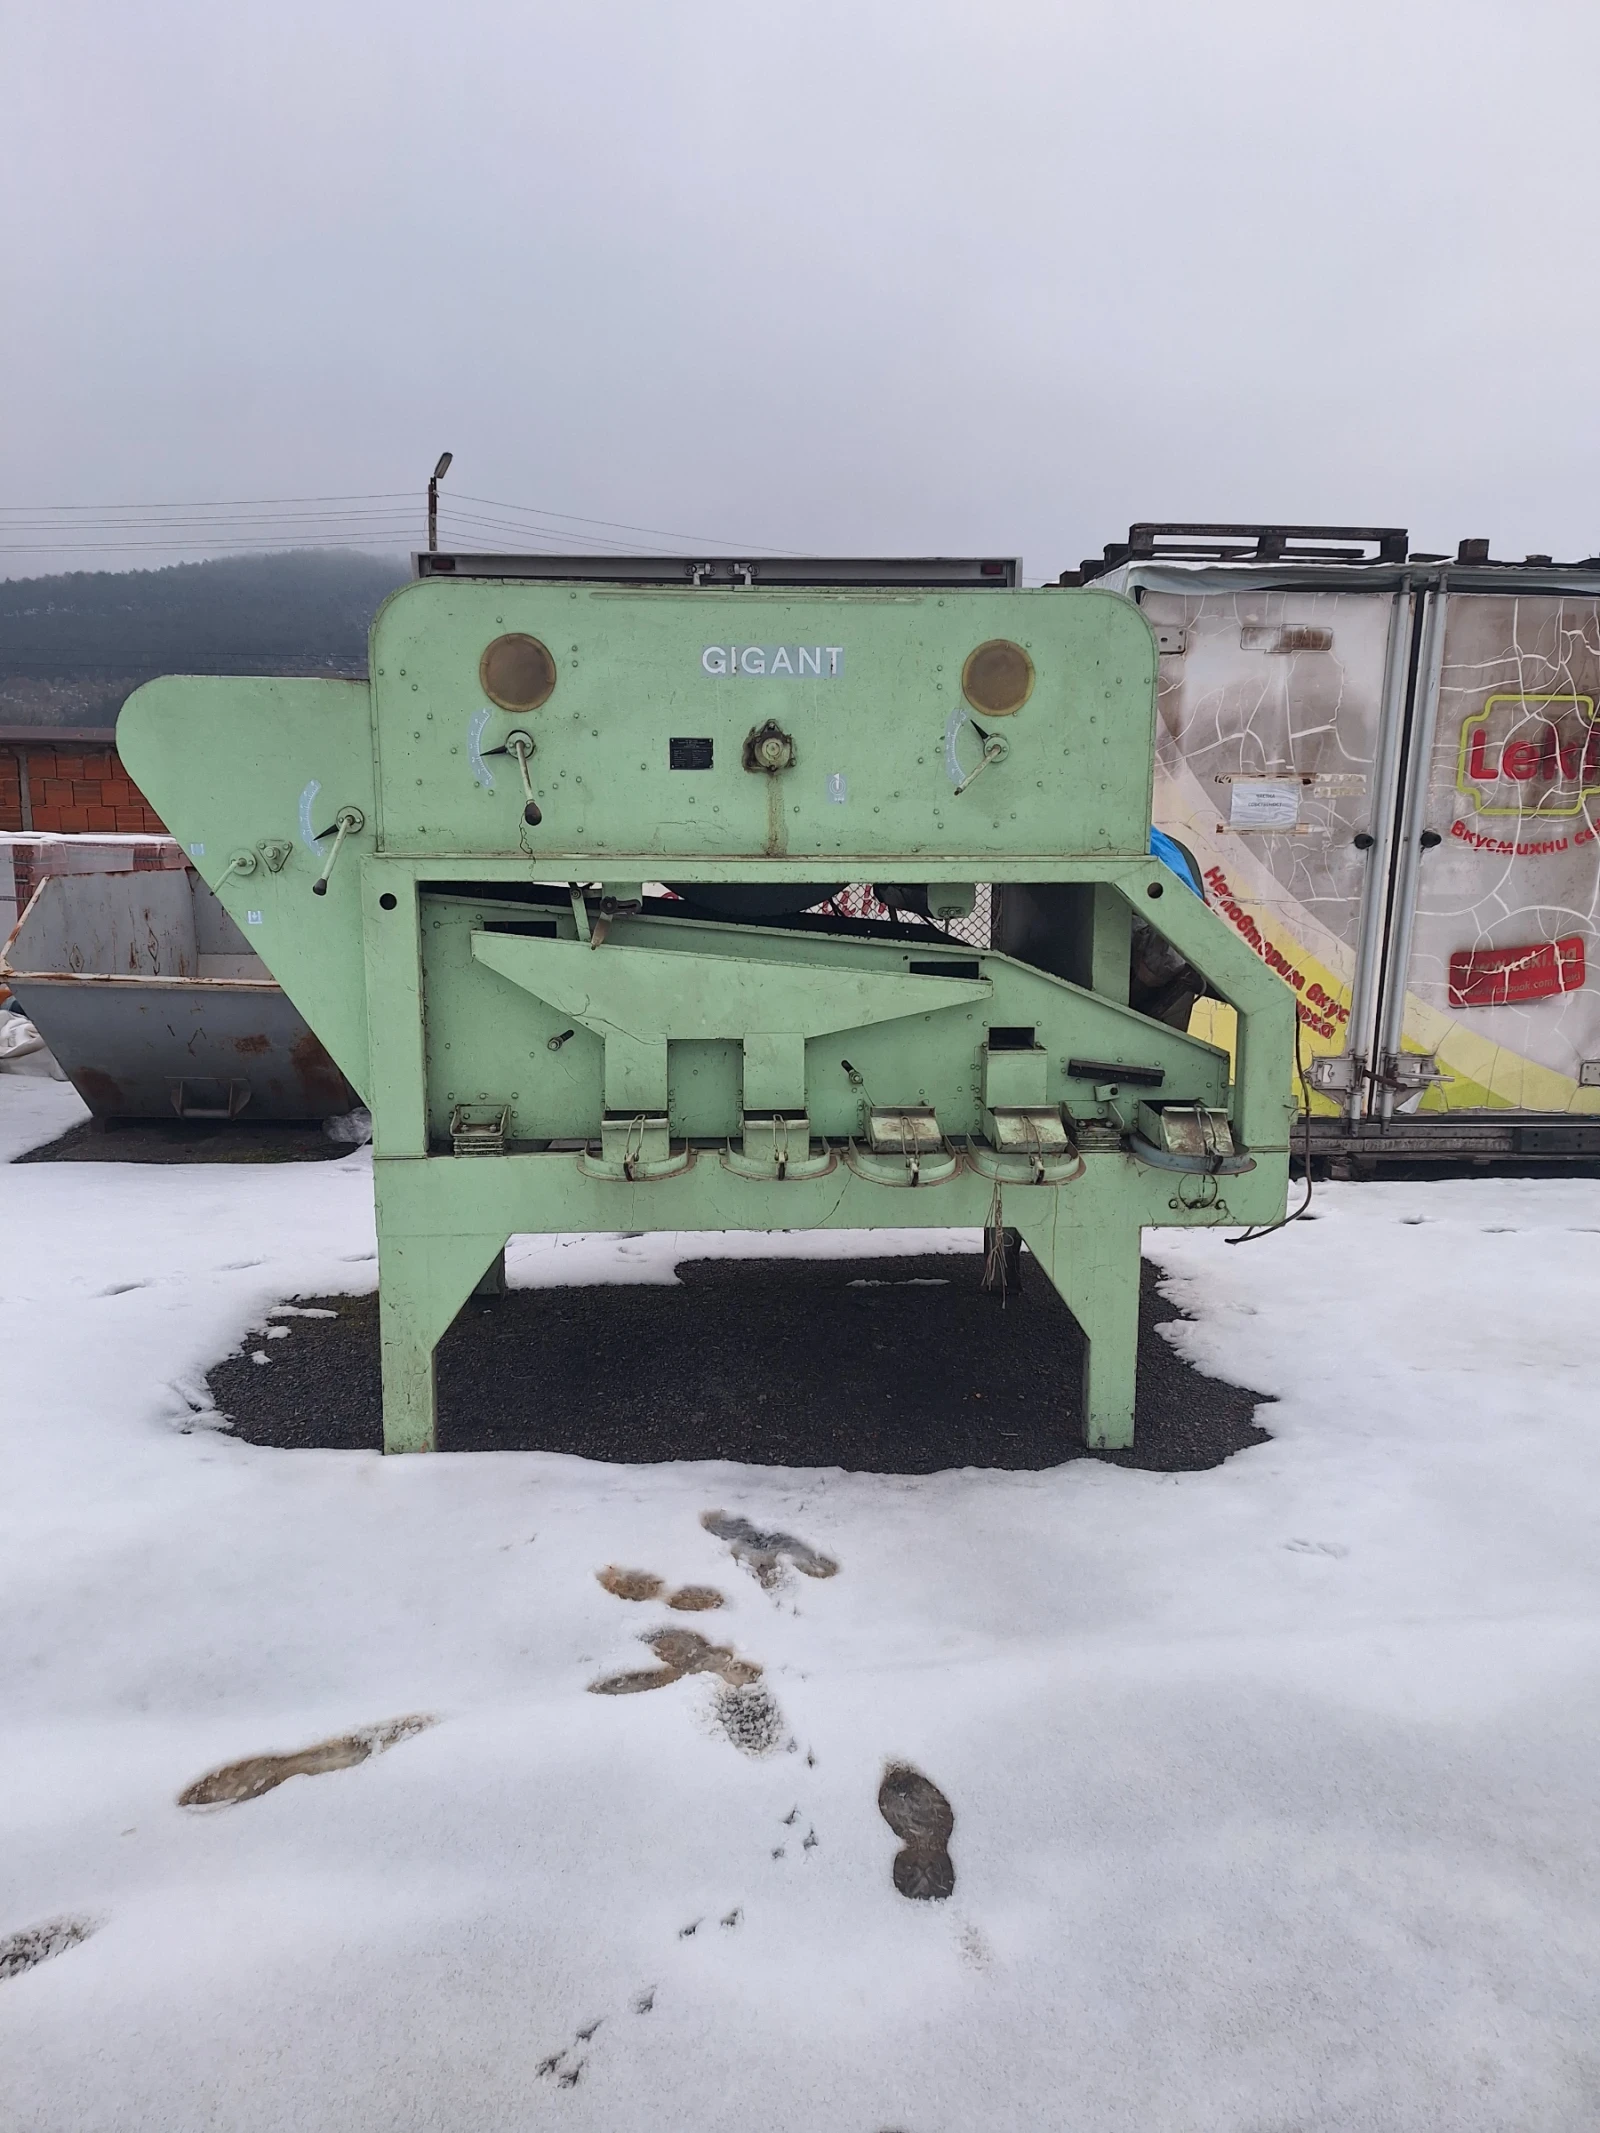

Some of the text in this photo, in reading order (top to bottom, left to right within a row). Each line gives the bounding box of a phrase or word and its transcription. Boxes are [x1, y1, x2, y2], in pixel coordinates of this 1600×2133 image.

[702, 646, 844, 675] GIGANT
[1451, 820, 1569, 855] Вкусмихни
[1204, 865, 1306, 991] Неповторим
[1306, 983, 1350, 1024] вкус
